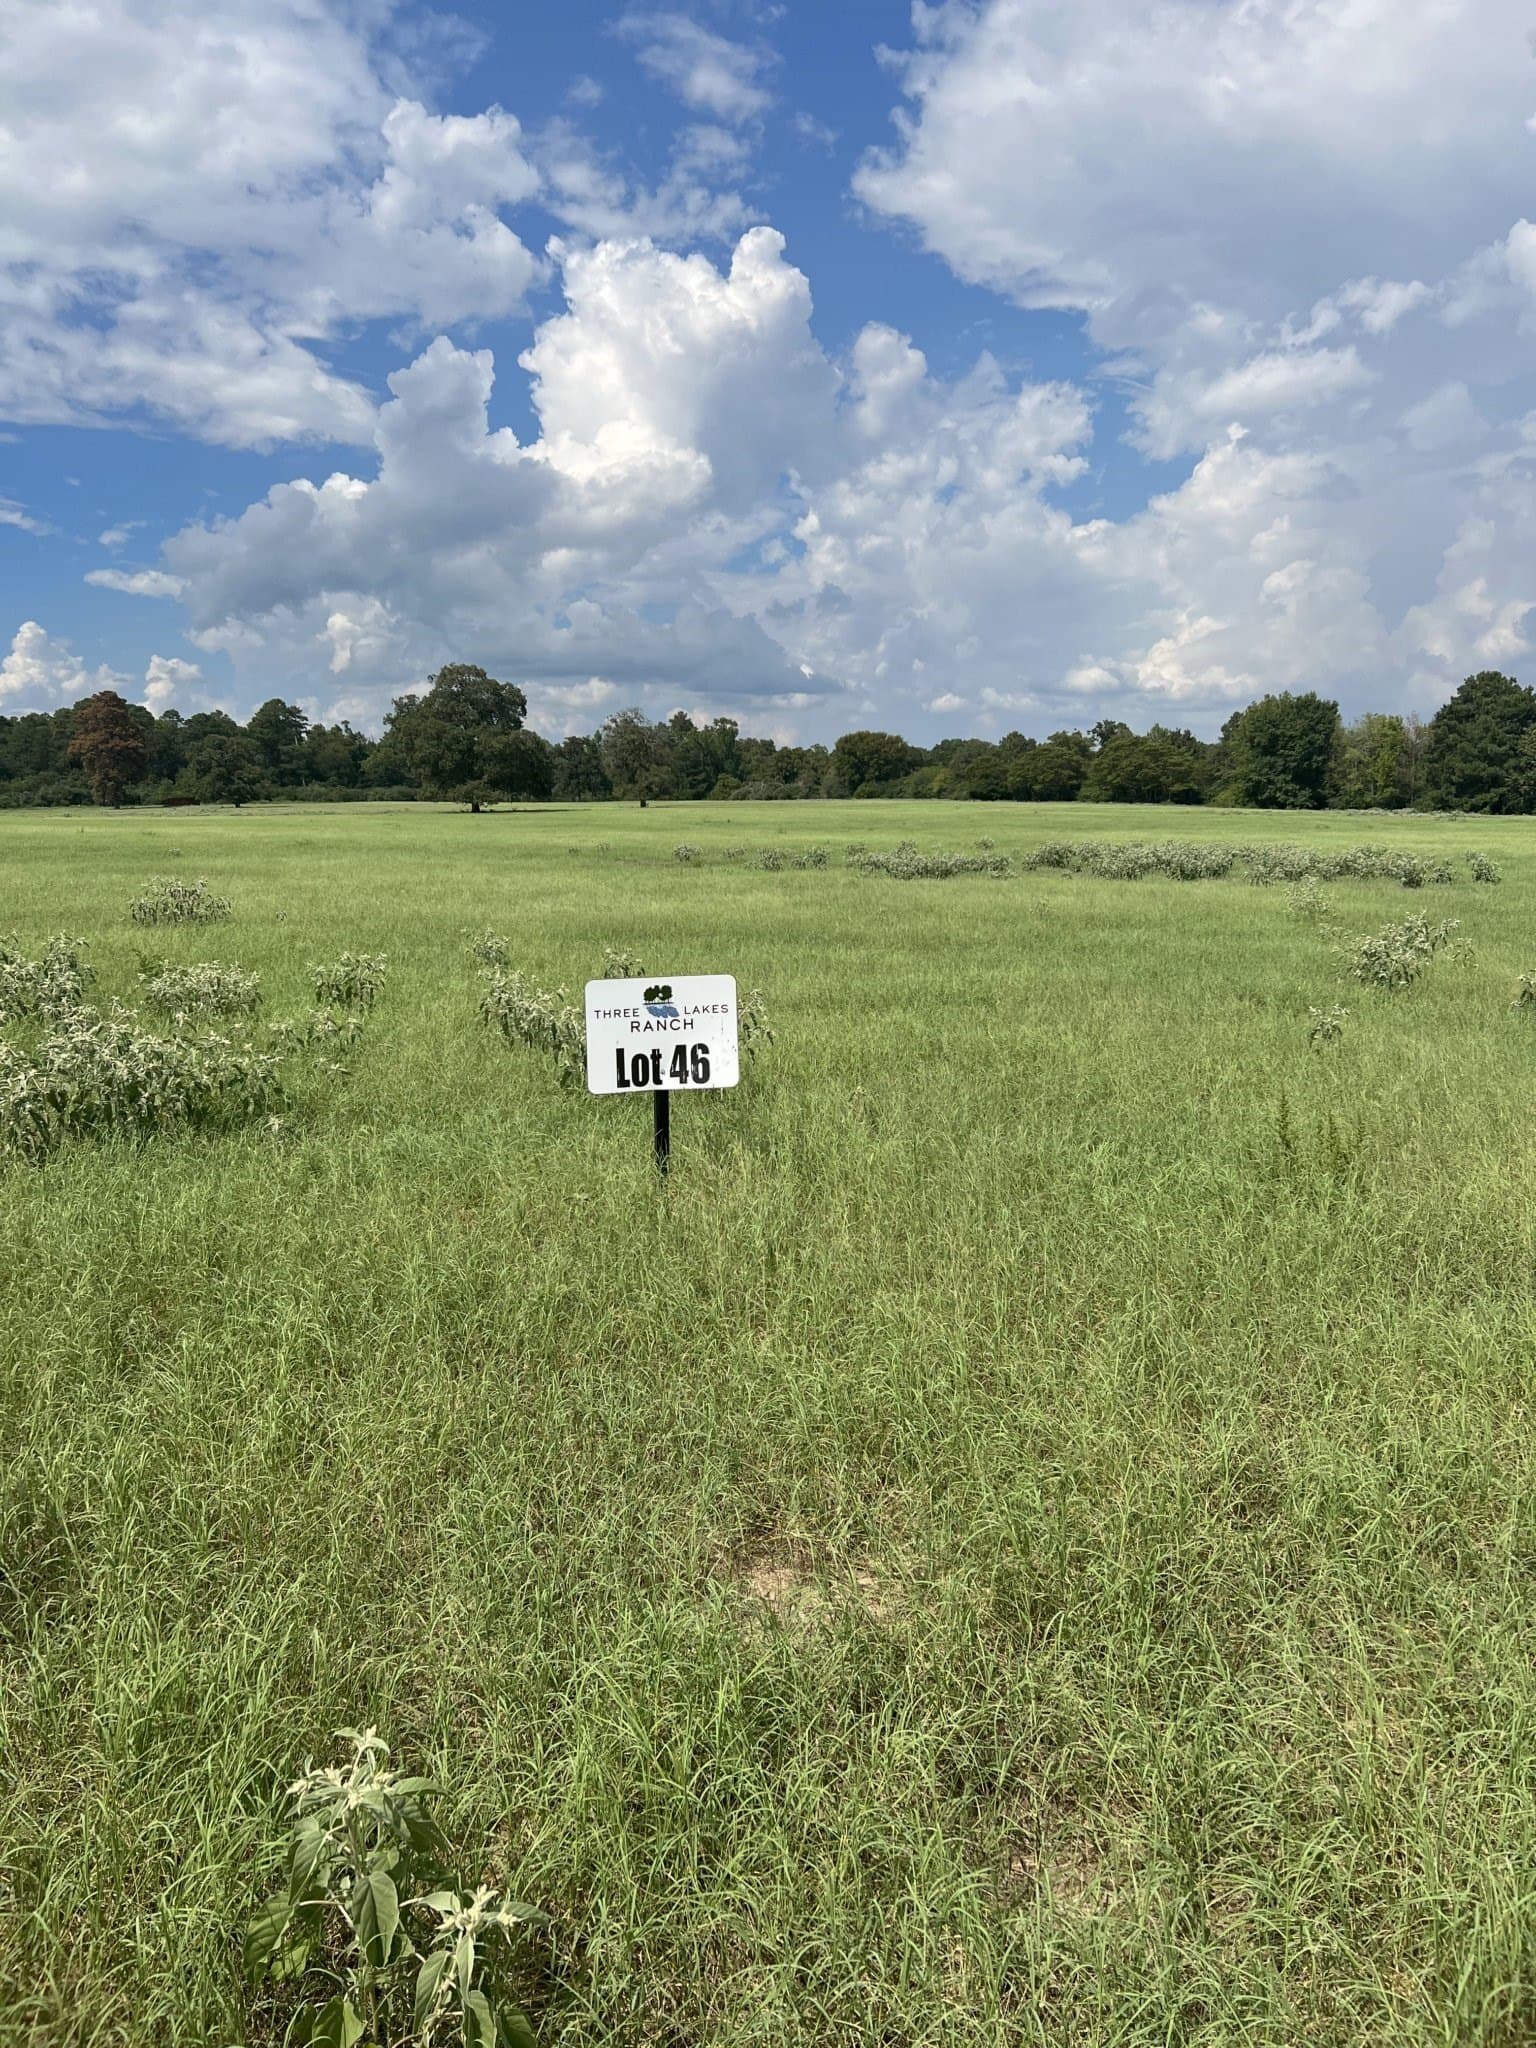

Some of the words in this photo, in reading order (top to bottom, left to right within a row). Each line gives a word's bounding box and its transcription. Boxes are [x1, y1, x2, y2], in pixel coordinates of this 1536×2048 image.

[594, 1008, 640, 1019] THREE
[684, 1004, 729, 1015] LAKES
[630, 1018, 694, 1033] RANCH
[616, 1047, 663, 1088] Lot
[669, 1043, 711, 1084] 46
